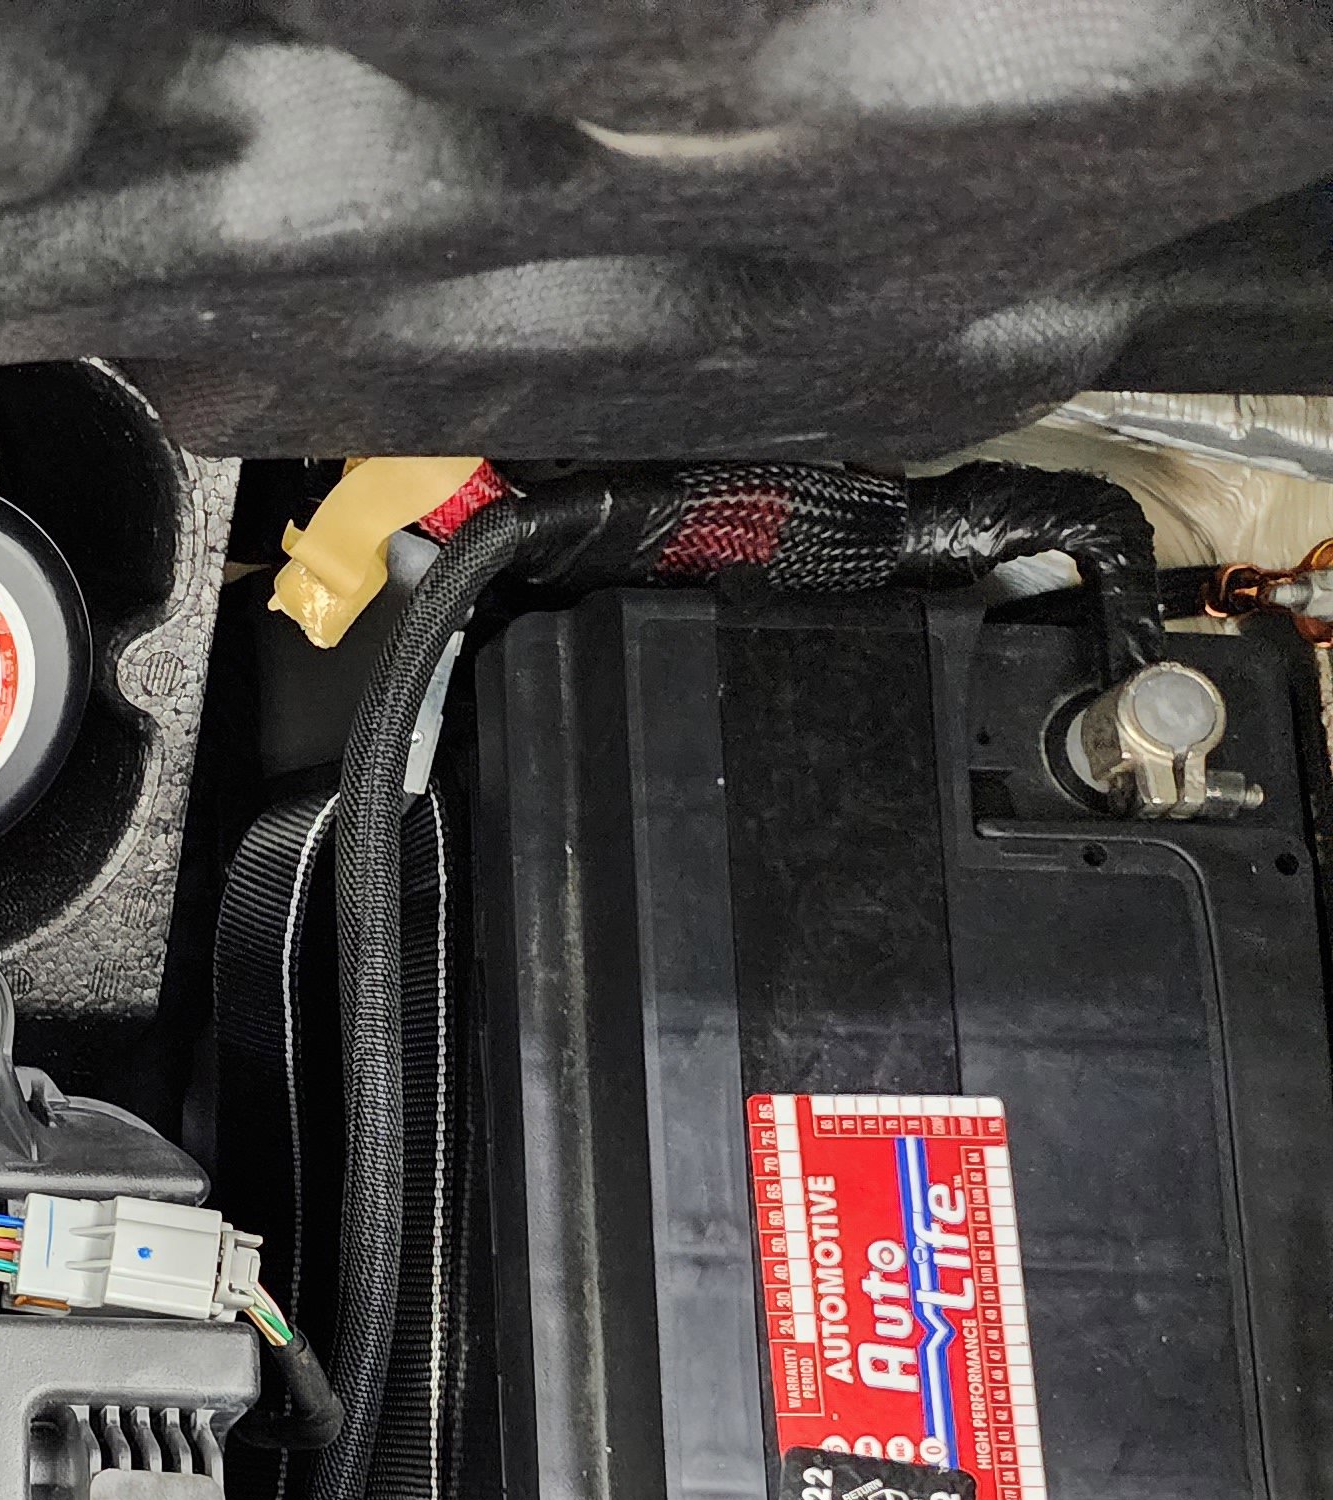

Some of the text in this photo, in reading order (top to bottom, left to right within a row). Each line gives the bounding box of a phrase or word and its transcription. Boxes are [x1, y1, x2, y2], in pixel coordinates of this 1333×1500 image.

[759, 1103, 793, 1335] 24 30 40 50 60 65 70 75 85
[807, 1175, 854, 1385] AUTOMOTIVE
[913, 1182, 975, 1311] Life
[783, 1347, 802, 1409] WARRANTY
[800, 1357, 816, 1399] PERIOD
[858, 1238, 920, 1393] Auto
[896, 1442, 906, 1457] DEC
[926, 1446, 942, 1455] 0
[962, 1318, 993, 1470] HIGH PERFORMANCE
